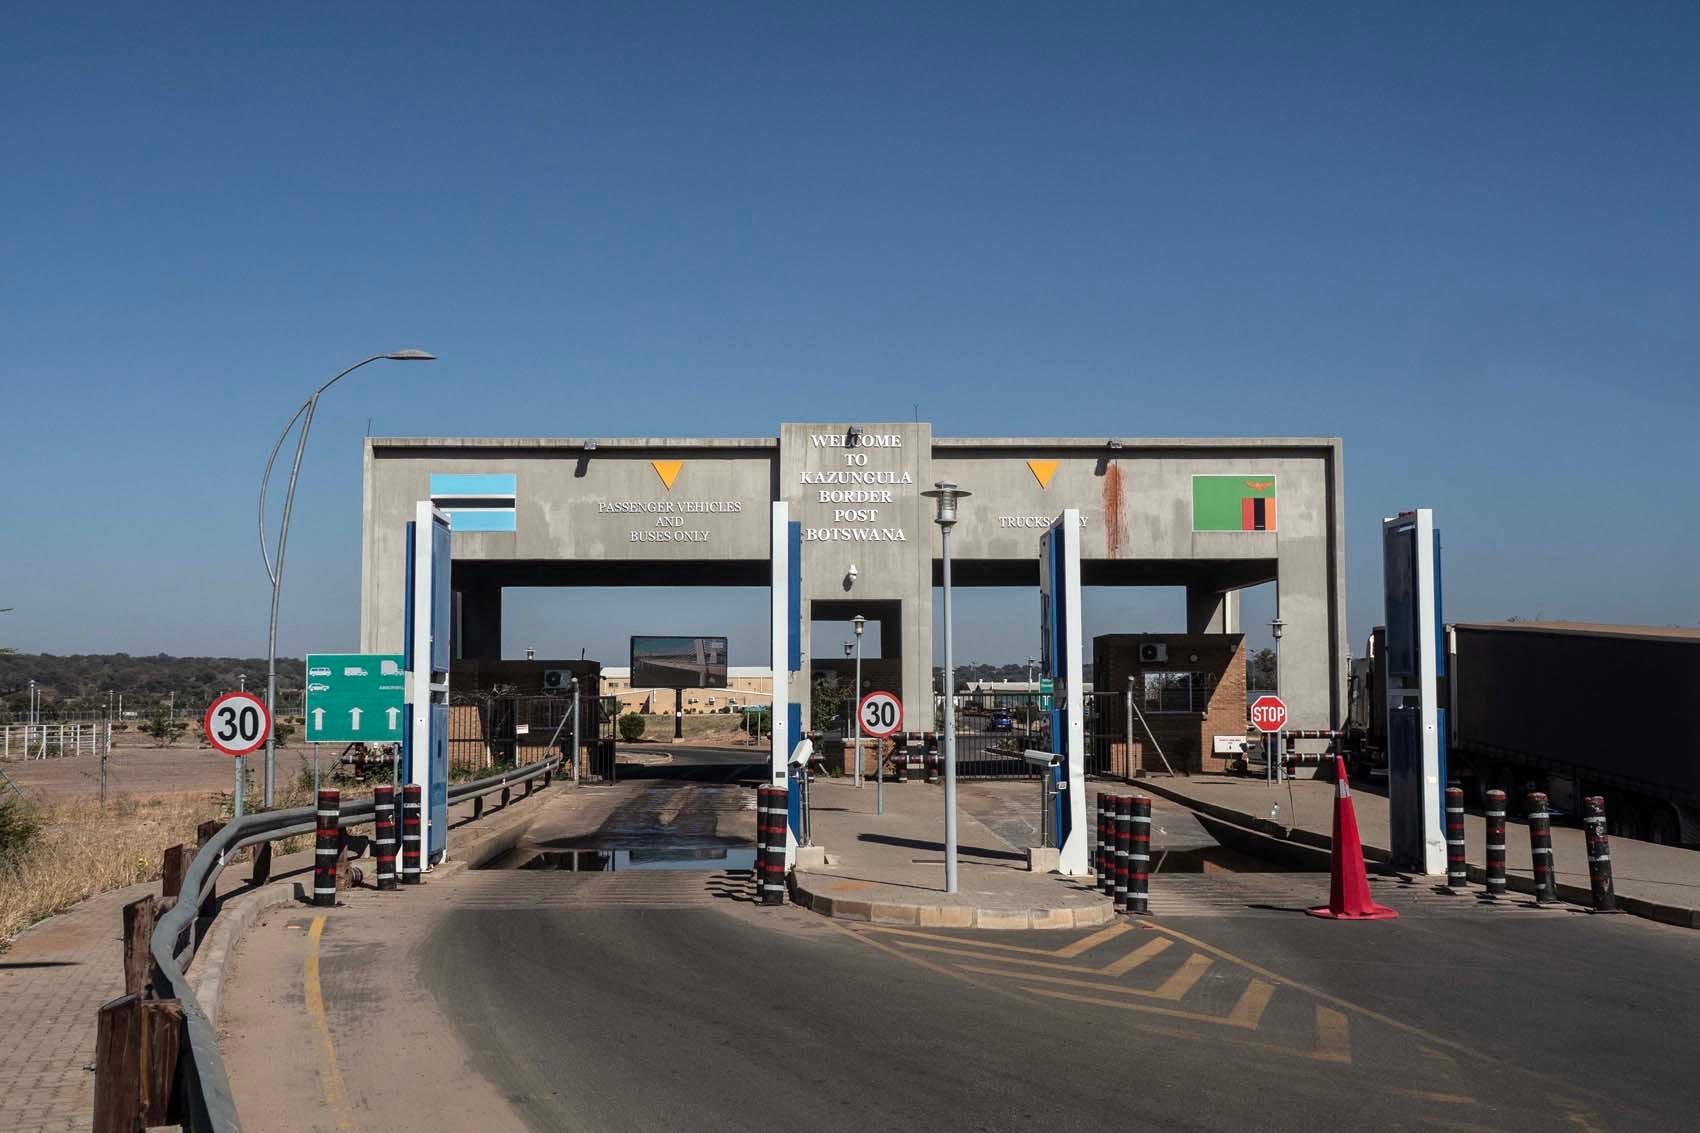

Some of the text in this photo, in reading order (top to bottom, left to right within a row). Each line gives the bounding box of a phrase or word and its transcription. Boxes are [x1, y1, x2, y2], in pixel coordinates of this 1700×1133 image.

[811, 434, 902, 448] WELCOME
[844, 453, 868, 467] TO
[800, 471, 912, 484] KAZUNGULA
[819, 490, 893, 503] BORDER
[598, 501, 742, 513] PASSENGER VEHICLES
[655, 516, 684, 527] AND
[833, 509, 879, 522] POST
[998, 516, 1050, 528] TRUCKS
[630, 530, 710, 542] BUSES ONLY
[806, 528, 907, 541] BOTSWANA
[865, 701, 895, 727] 30
[1253, 706, 1285, 722] STOP
[217, 705, 259, 742] 30
